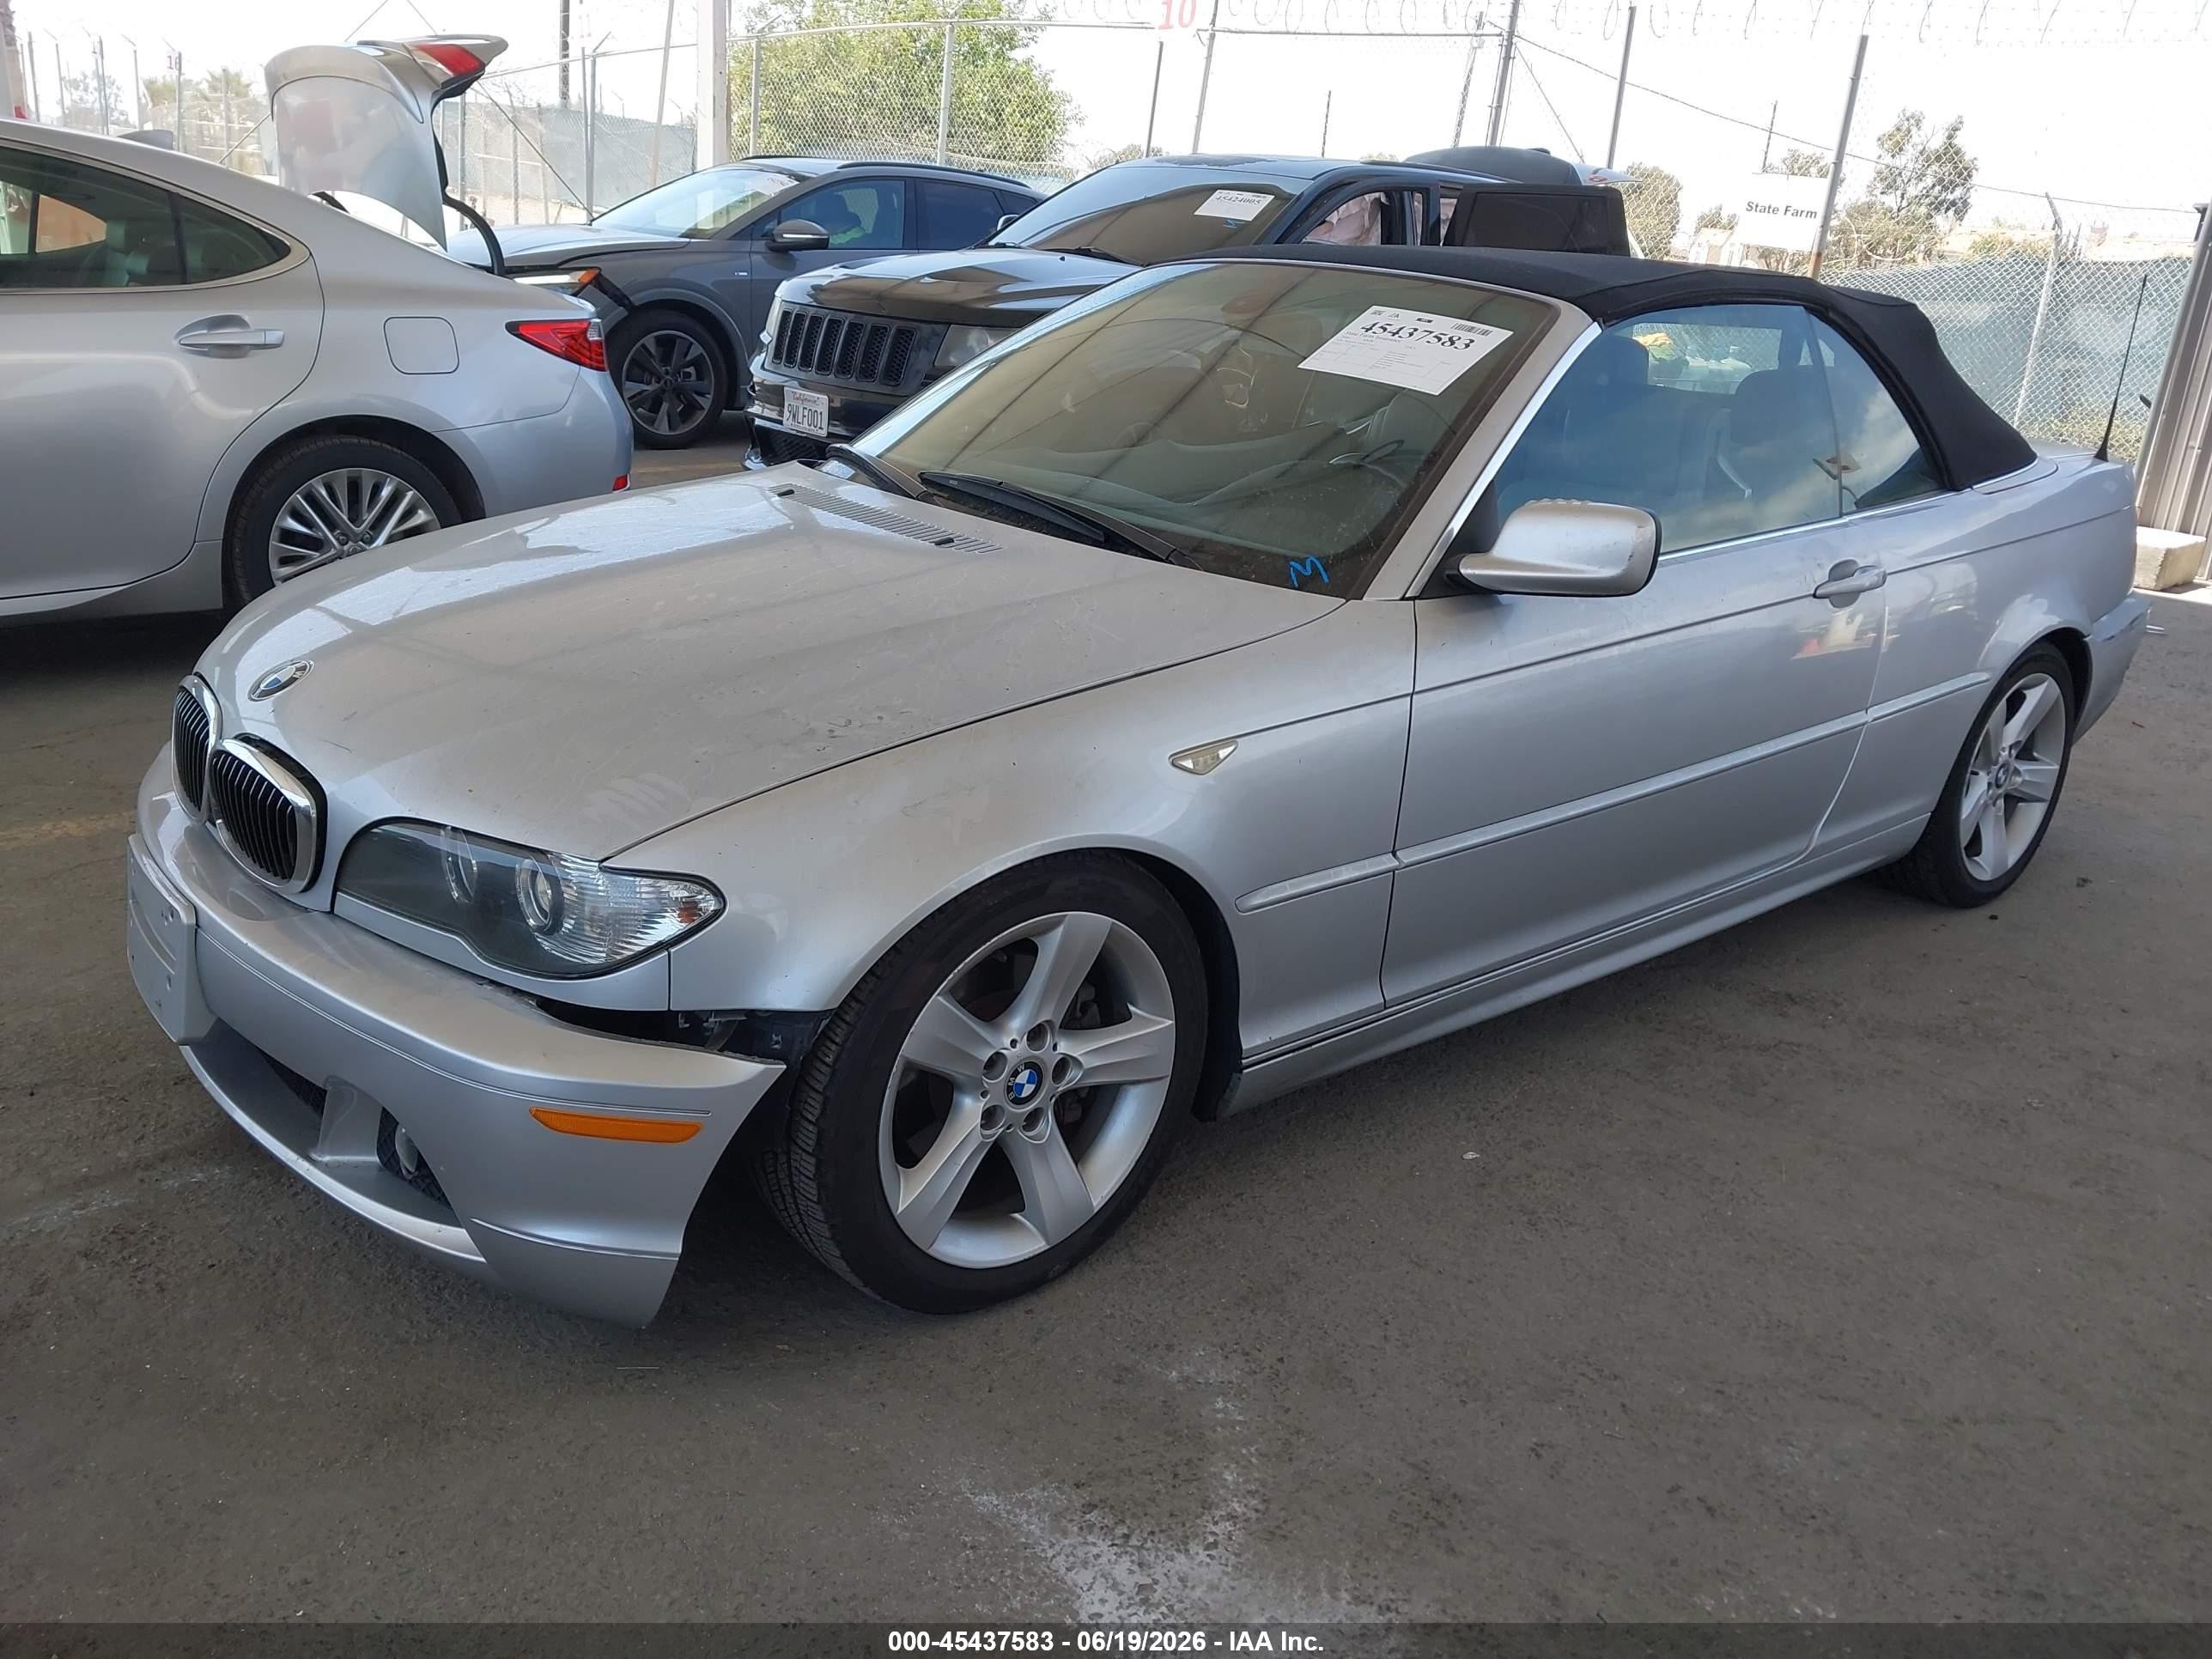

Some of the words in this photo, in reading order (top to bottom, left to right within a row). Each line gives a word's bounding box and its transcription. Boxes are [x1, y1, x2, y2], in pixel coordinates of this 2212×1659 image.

[1158, 0, 1196, 30] 10
[1746, 201, 1780, 216] State
[1784, 205, 1818, 220] Farm
[1359, 321, 1475, 351] 45437583
[1289, 555, 1330, 588] M
[1008, 1063, 1025, 1100] BMW
